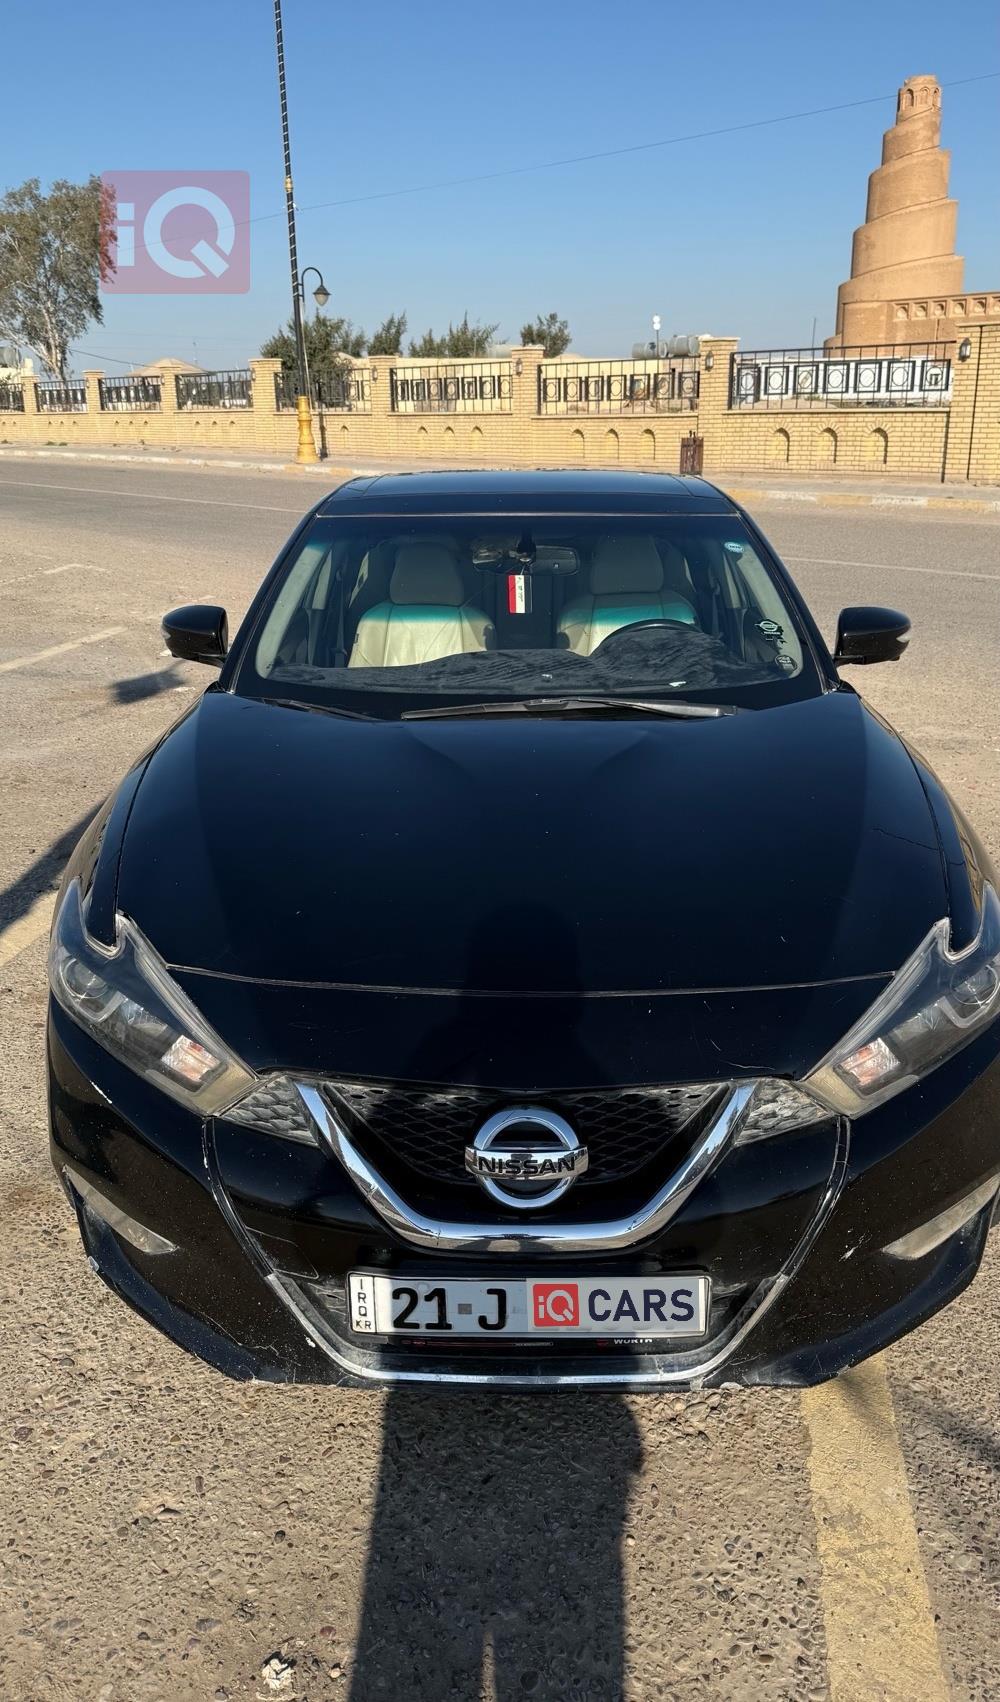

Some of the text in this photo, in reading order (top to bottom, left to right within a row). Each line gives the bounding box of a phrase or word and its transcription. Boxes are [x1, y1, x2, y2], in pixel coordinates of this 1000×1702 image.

[478, 1156, 575, 1174] NISSAN
[392, 1287, 507, 1331] 21 J
[355, 1319, 372, 1330] KR
